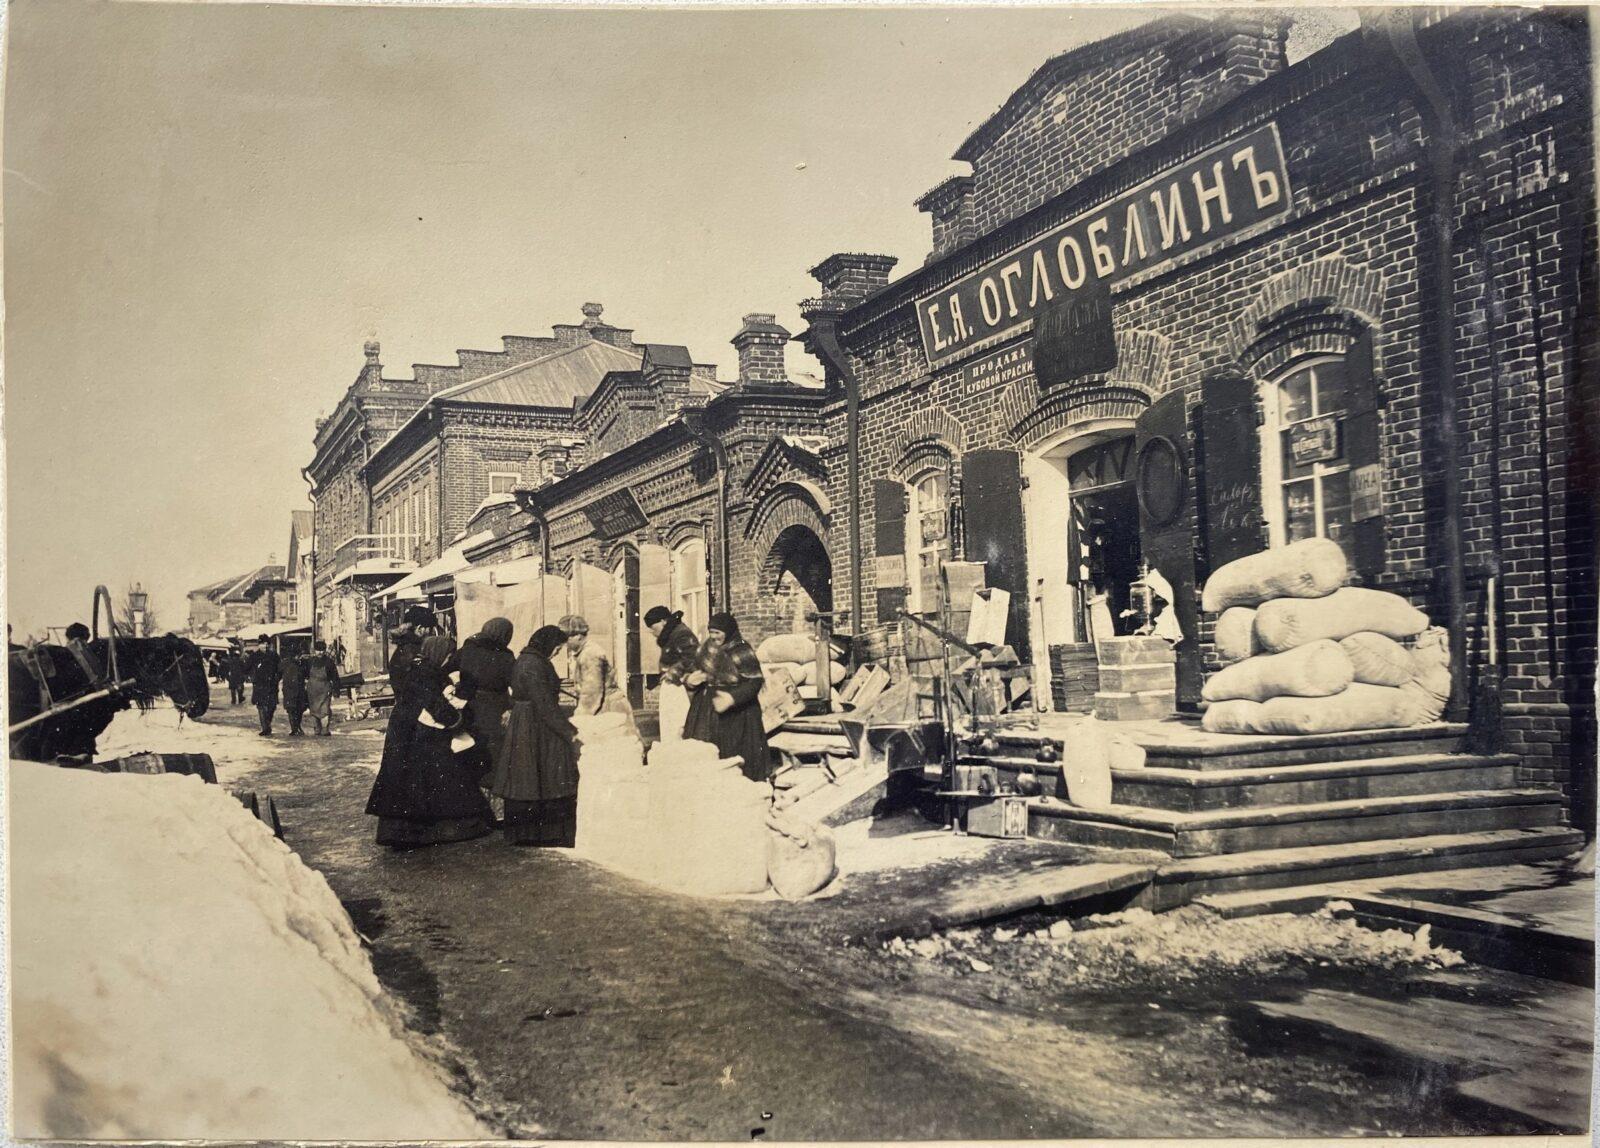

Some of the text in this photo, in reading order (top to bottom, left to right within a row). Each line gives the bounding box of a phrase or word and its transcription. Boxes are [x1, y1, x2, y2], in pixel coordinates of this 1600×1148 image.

[979, 146, 1280, 327] ОГЛОБЛИНЪ
[972, 347, 1026, 378] ПРОДАЖА
[966, 371, 1001, 395] КУБОВОЙ
